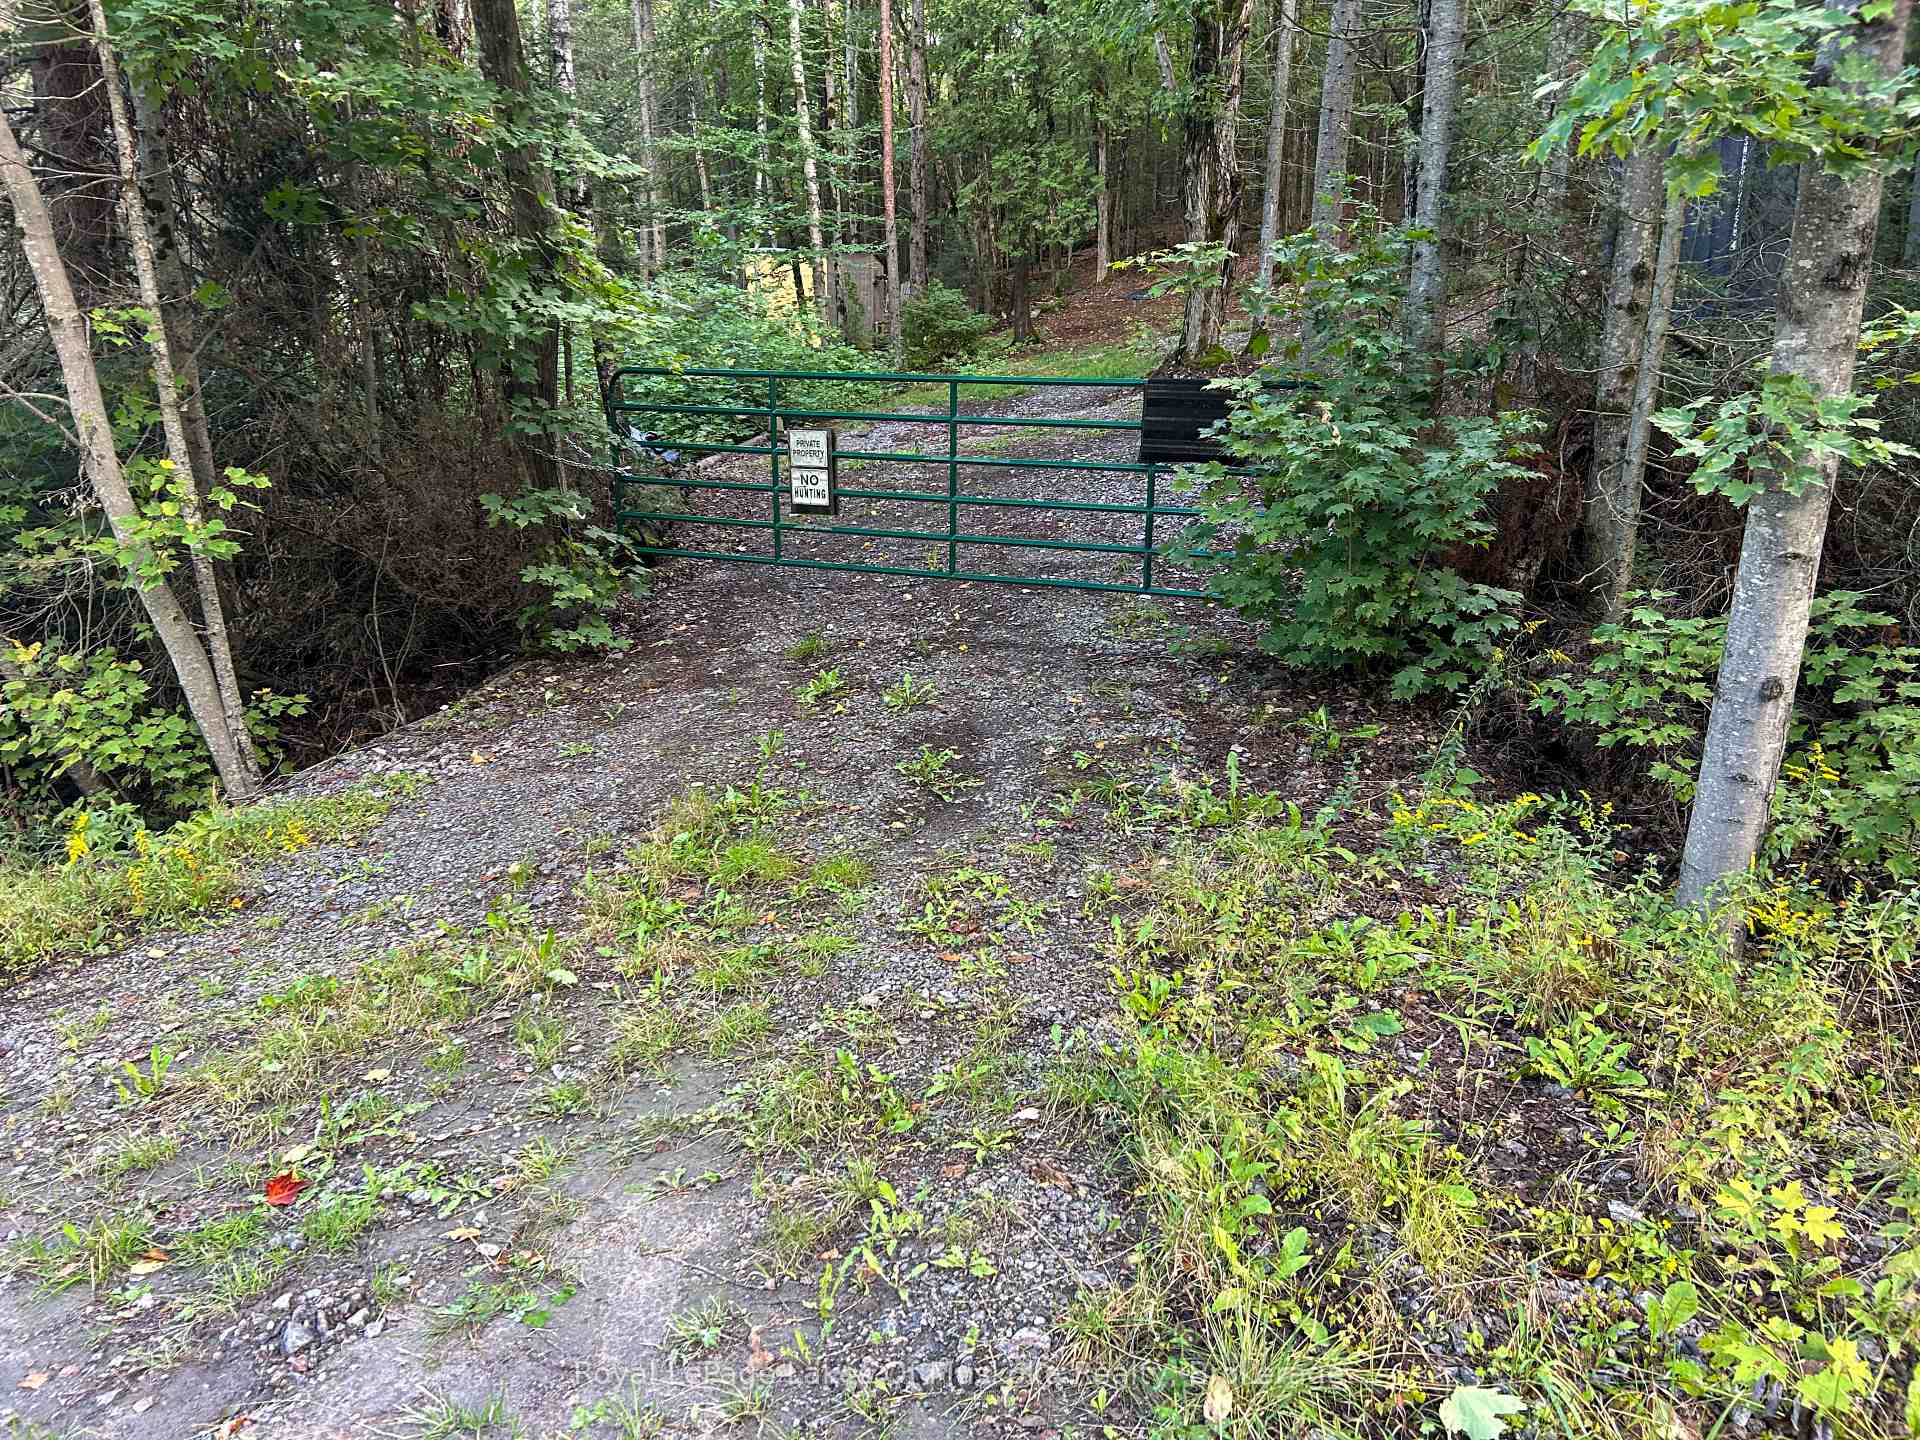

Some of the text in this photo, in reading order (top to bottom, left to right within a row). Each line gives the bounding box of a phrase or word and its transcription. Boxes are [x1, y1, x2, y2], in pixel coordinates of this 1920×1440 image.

[796, 440, 820, 448] PRIVATE
[793, 449, 824, 457] PROPERTY
[800, 475, 819, 485] NO
[794, 488, 826, 499] HUNTING
